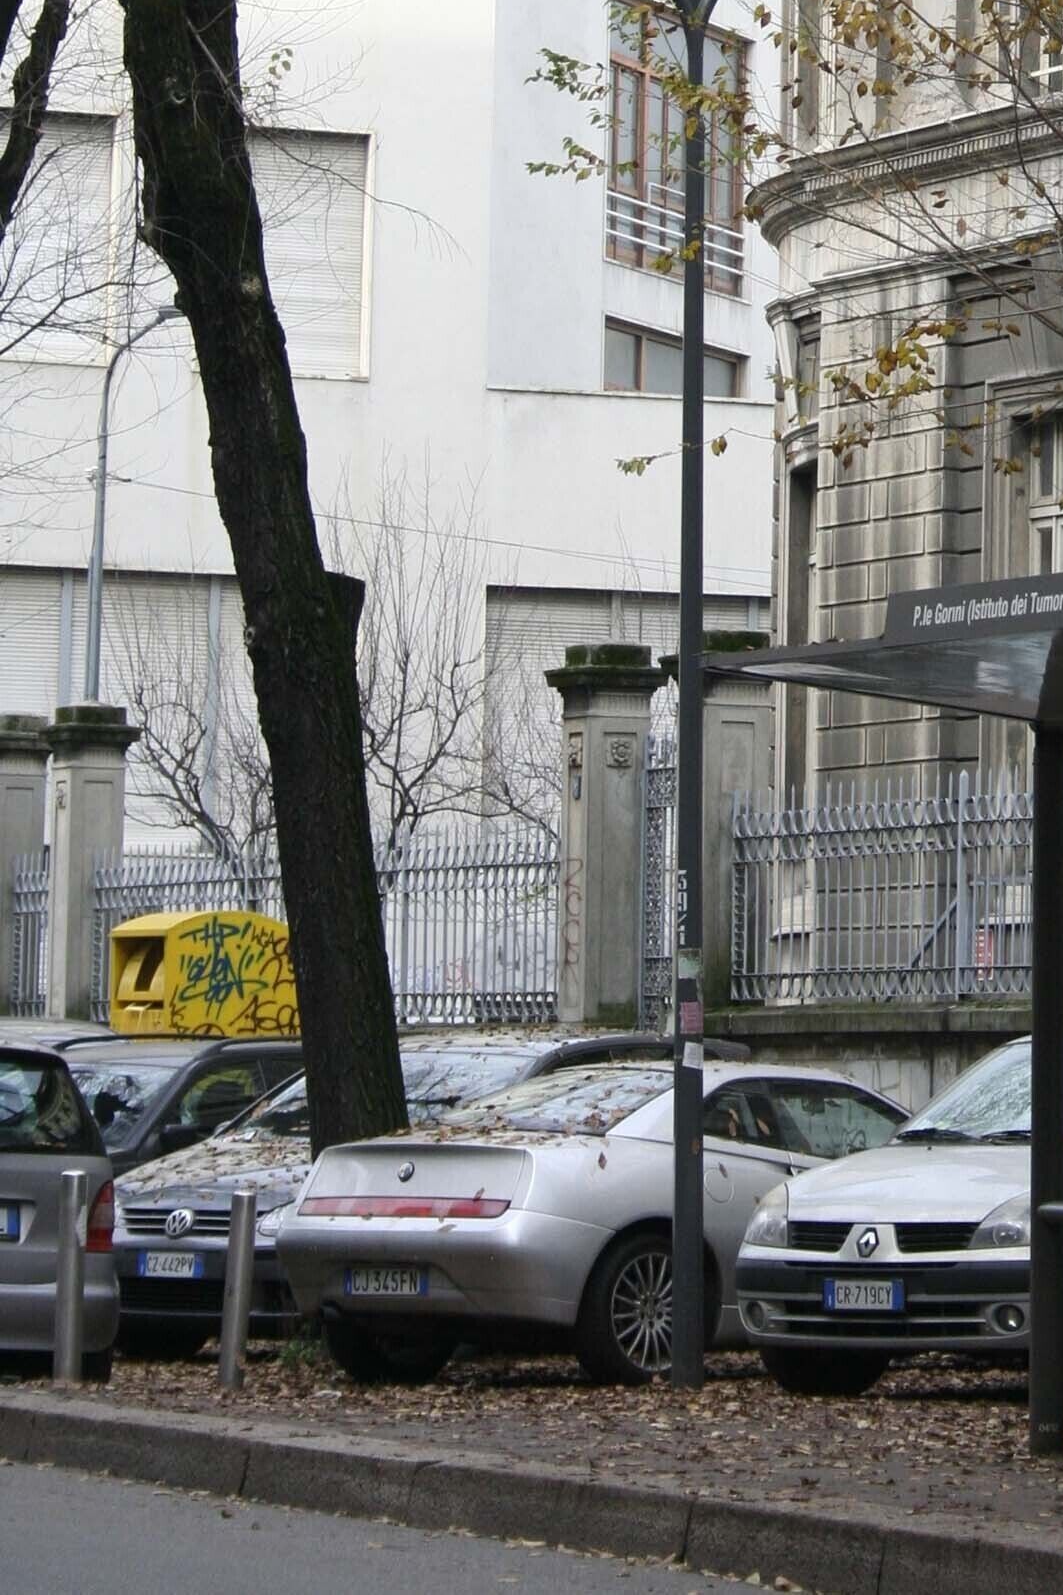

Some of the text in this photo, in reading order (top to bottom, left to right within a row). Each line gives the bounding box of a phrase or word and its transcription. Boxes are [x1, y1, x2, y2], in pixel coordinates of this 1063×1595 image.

[912, 605, 932, 627] P.le
[967, 596, 1009, 625] (Istituto
[1010, 594, 1027, 617] dei
